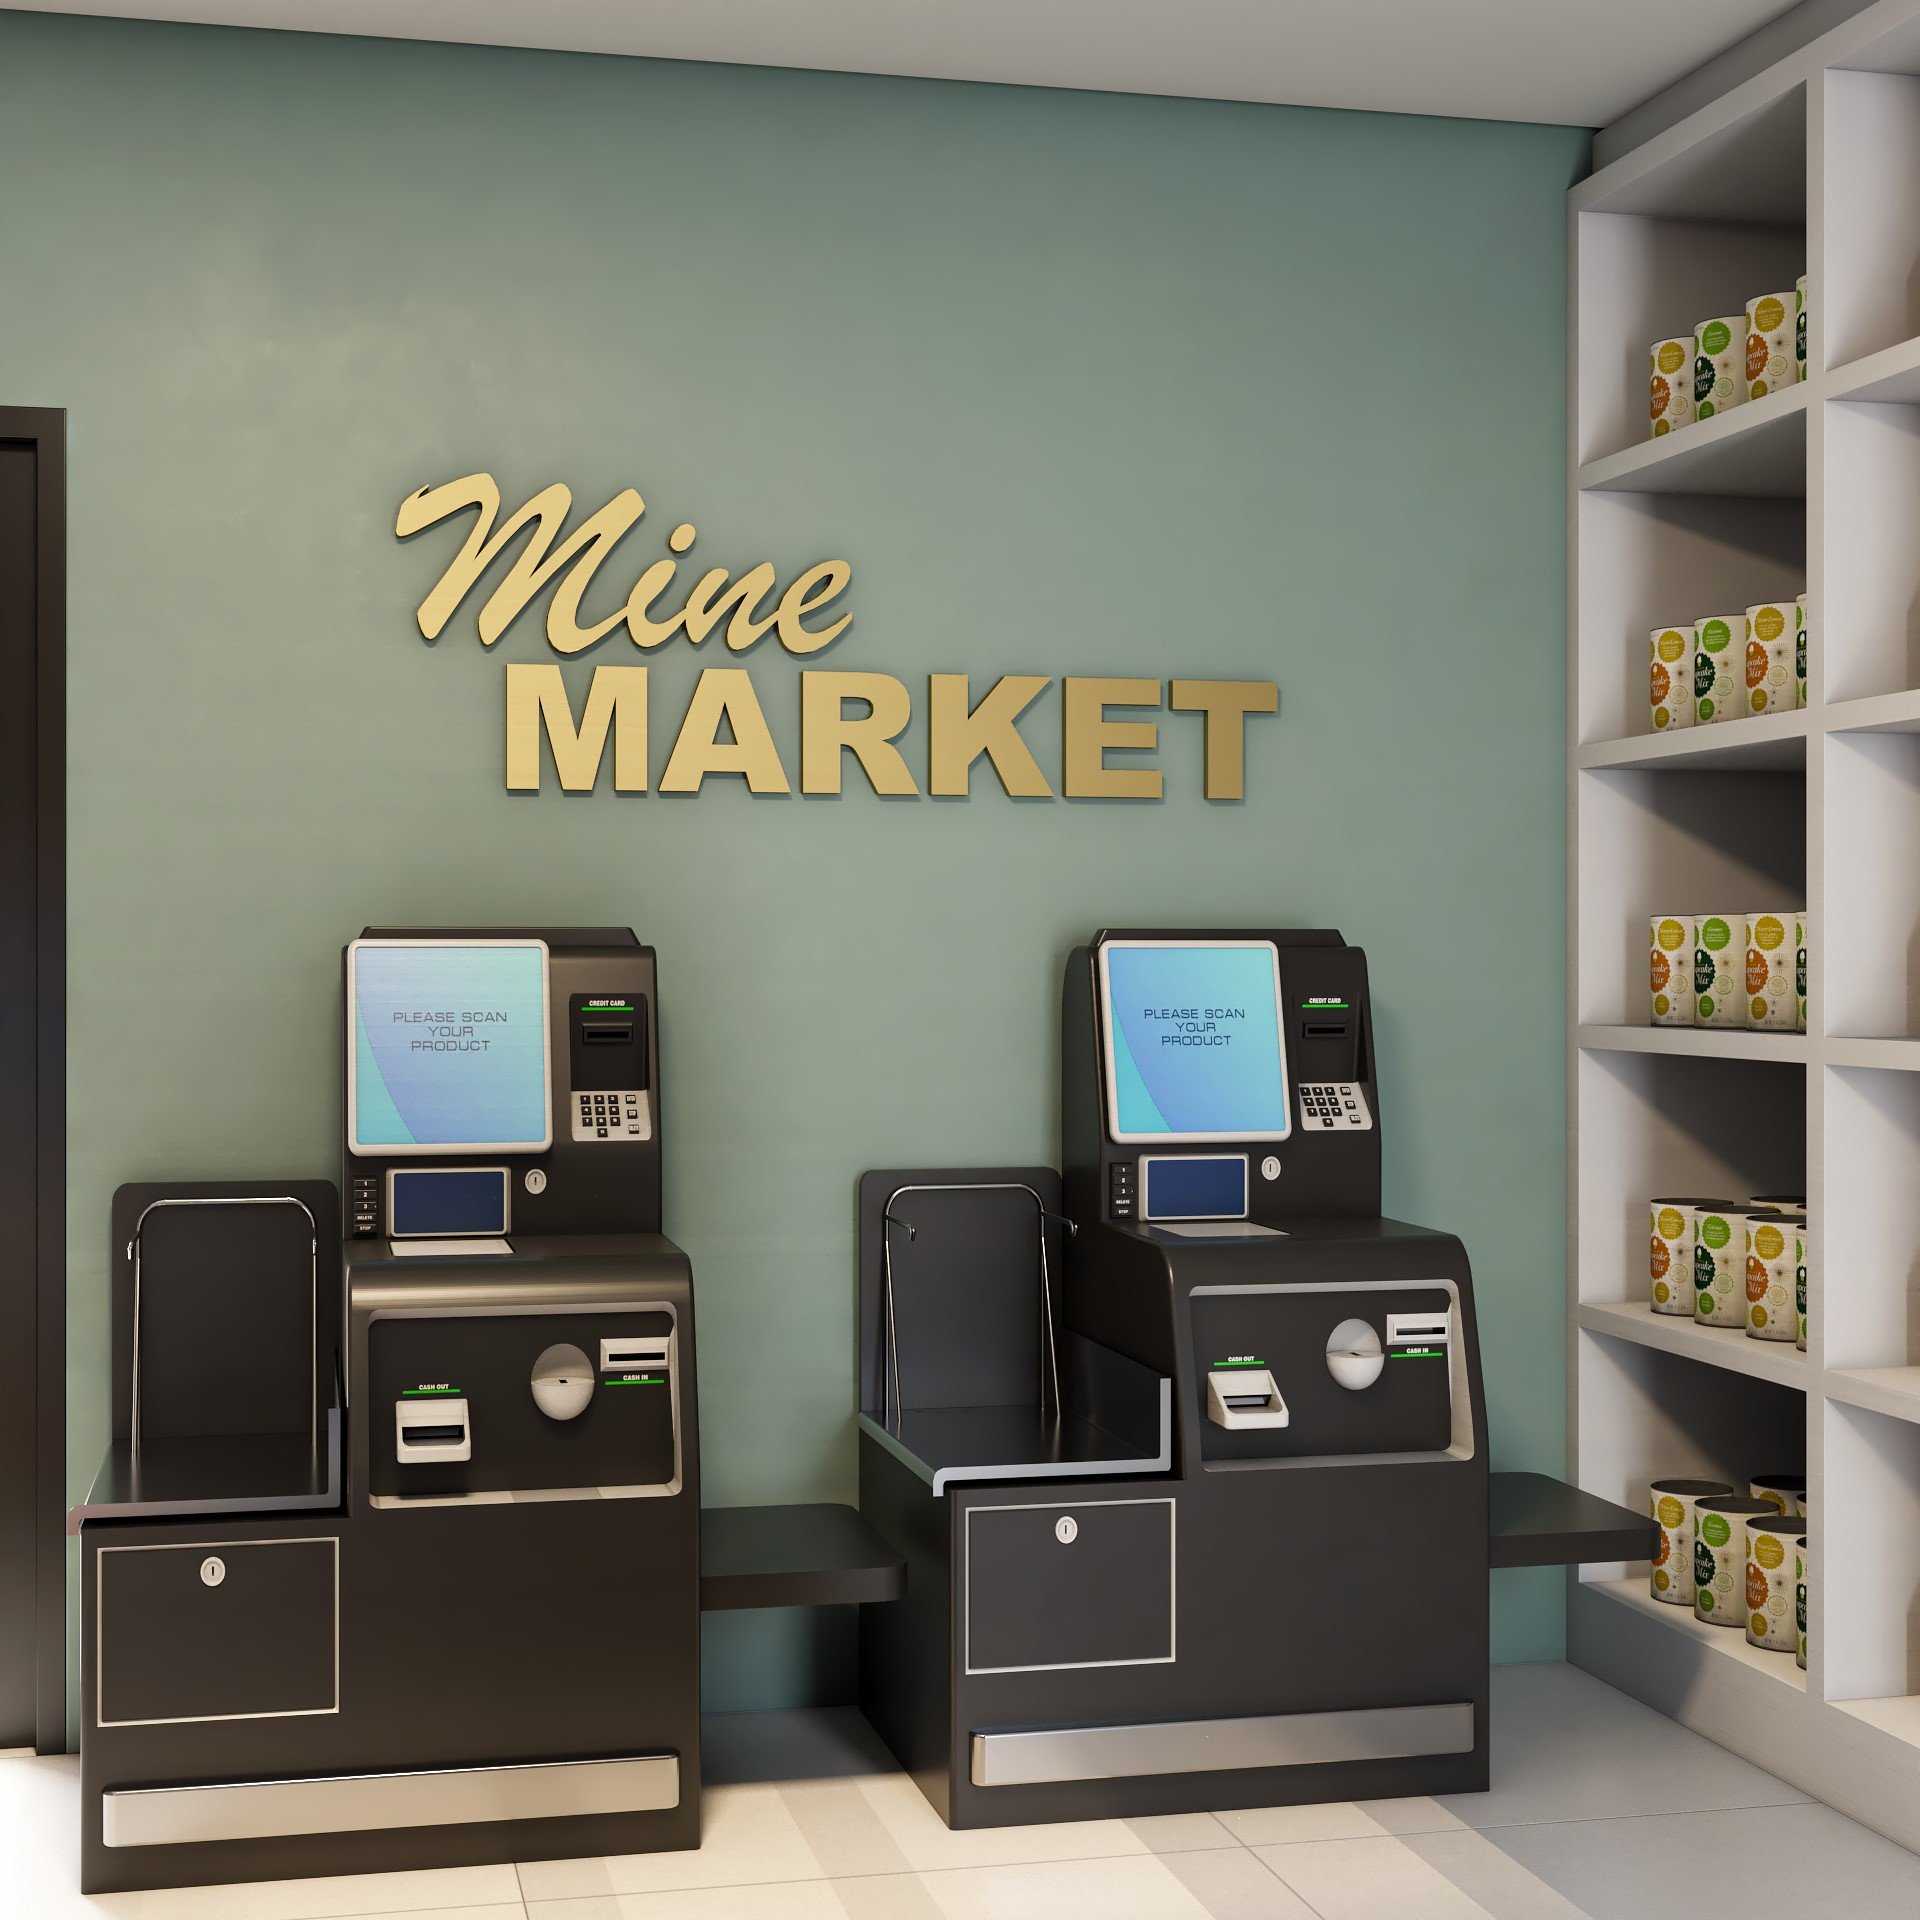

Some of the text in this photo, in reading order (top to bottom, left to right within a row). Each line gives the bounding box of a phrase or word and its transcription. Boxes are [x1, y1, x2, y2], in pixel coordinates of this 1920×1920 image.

[395, 472, 853, 654] Mine
[506, 663, 1278, 800] MARKET
[393, 1012, 508, 1023] PLEASE SCAN
[1144, 1008, 1246, 1019] PLEASE SCAN
[428, 1026, 474, 1037] YOUR
[1175, 1022, 1216, 1033] YOUR
[411, 1040, 491, 1052] PRODUCT
[1161, 1035, 1232, 1046] PRODUCT
